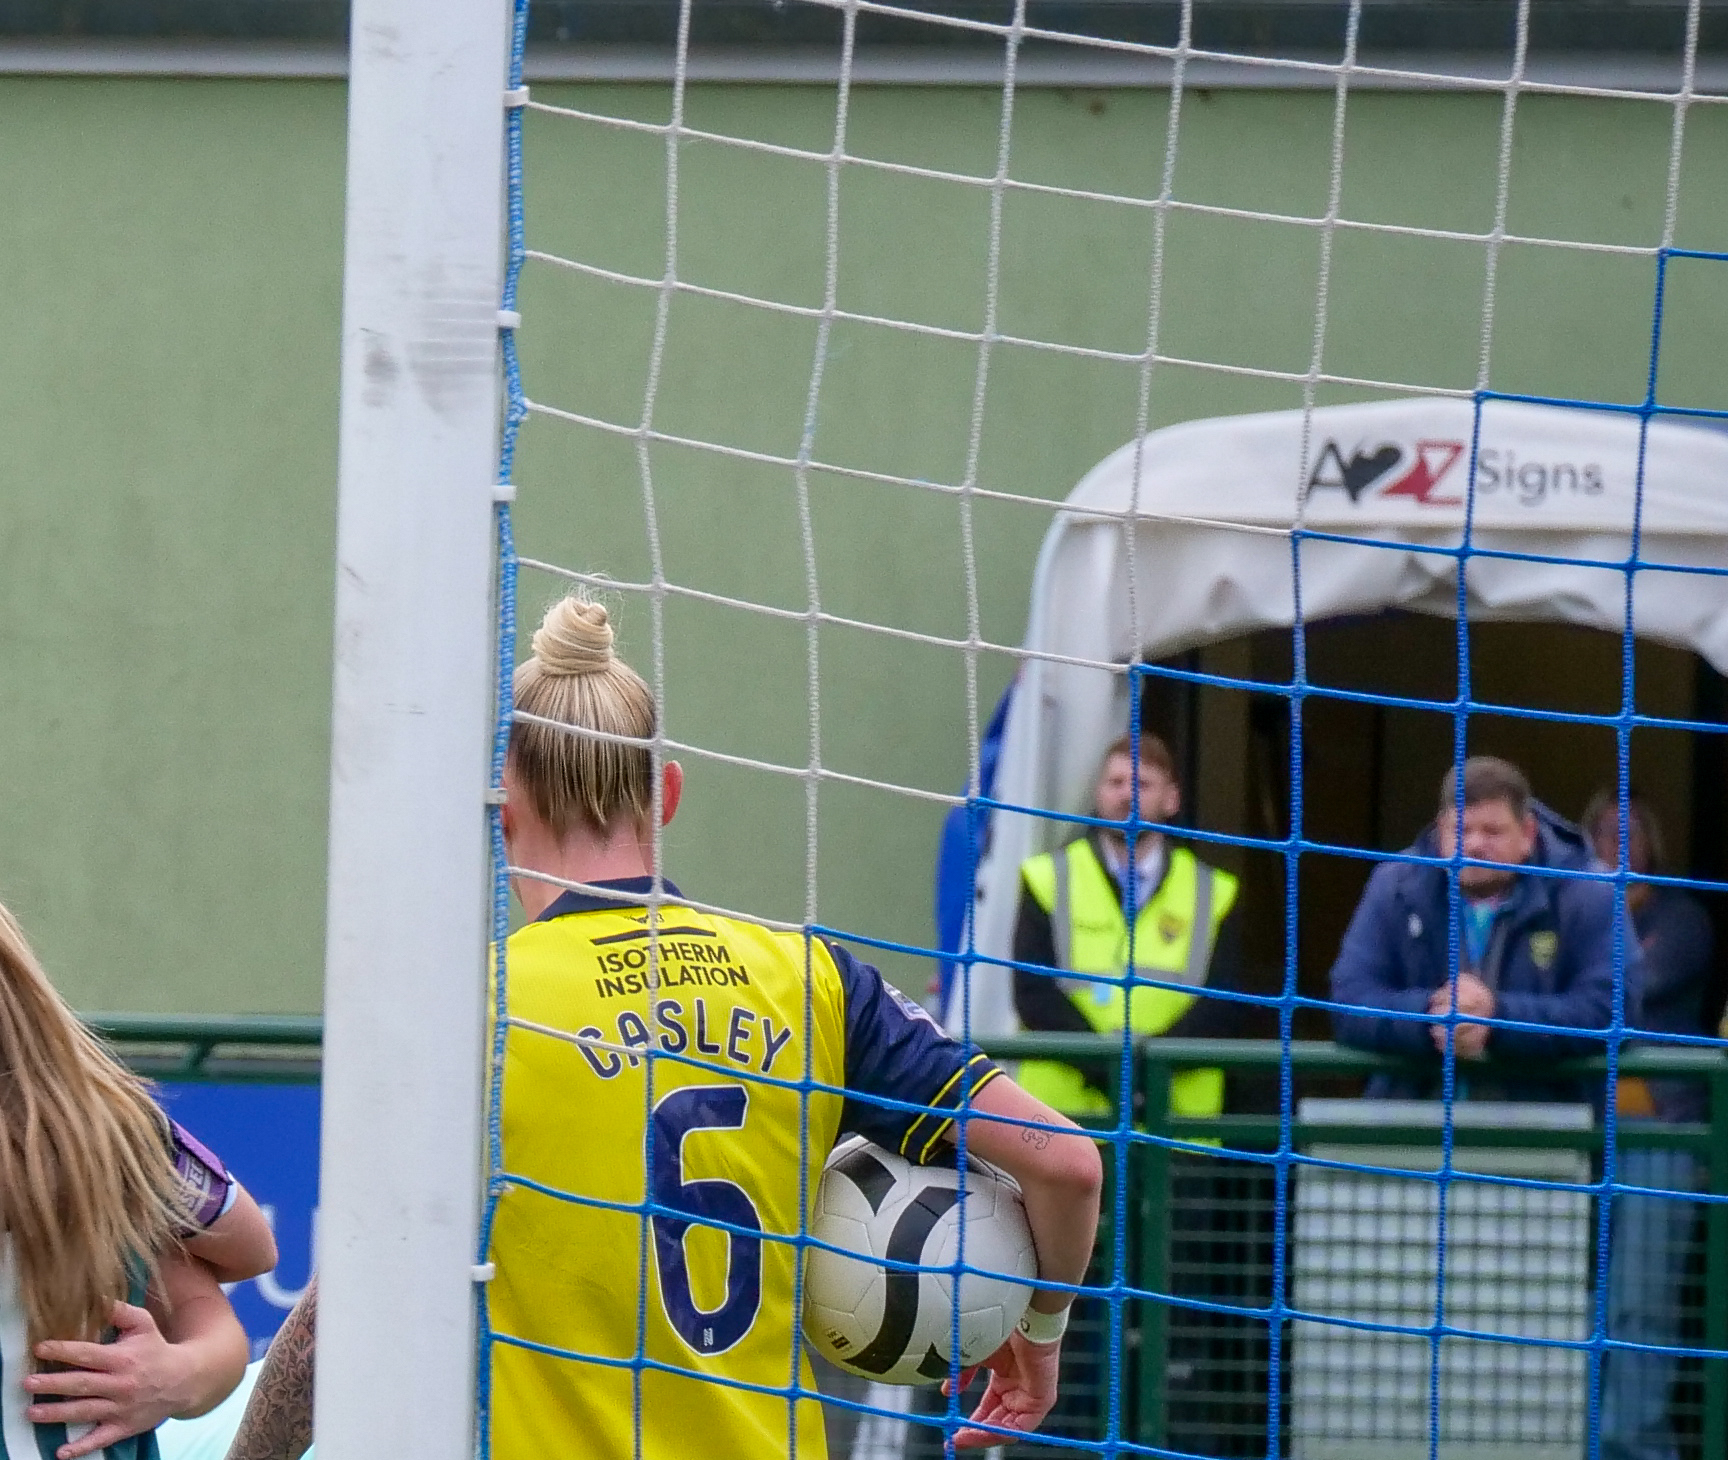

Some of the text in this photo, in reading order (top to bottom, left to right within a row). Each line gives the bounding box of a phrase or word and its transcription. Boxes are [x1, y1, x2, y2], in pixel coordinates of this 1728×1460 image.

[1475, 448, 1605, 507] Signs
[594, 965, 751, 999] INSULATION
[575, 997, 792, 1080] CASLEY
[644, 1084, 763, 1356] 6
